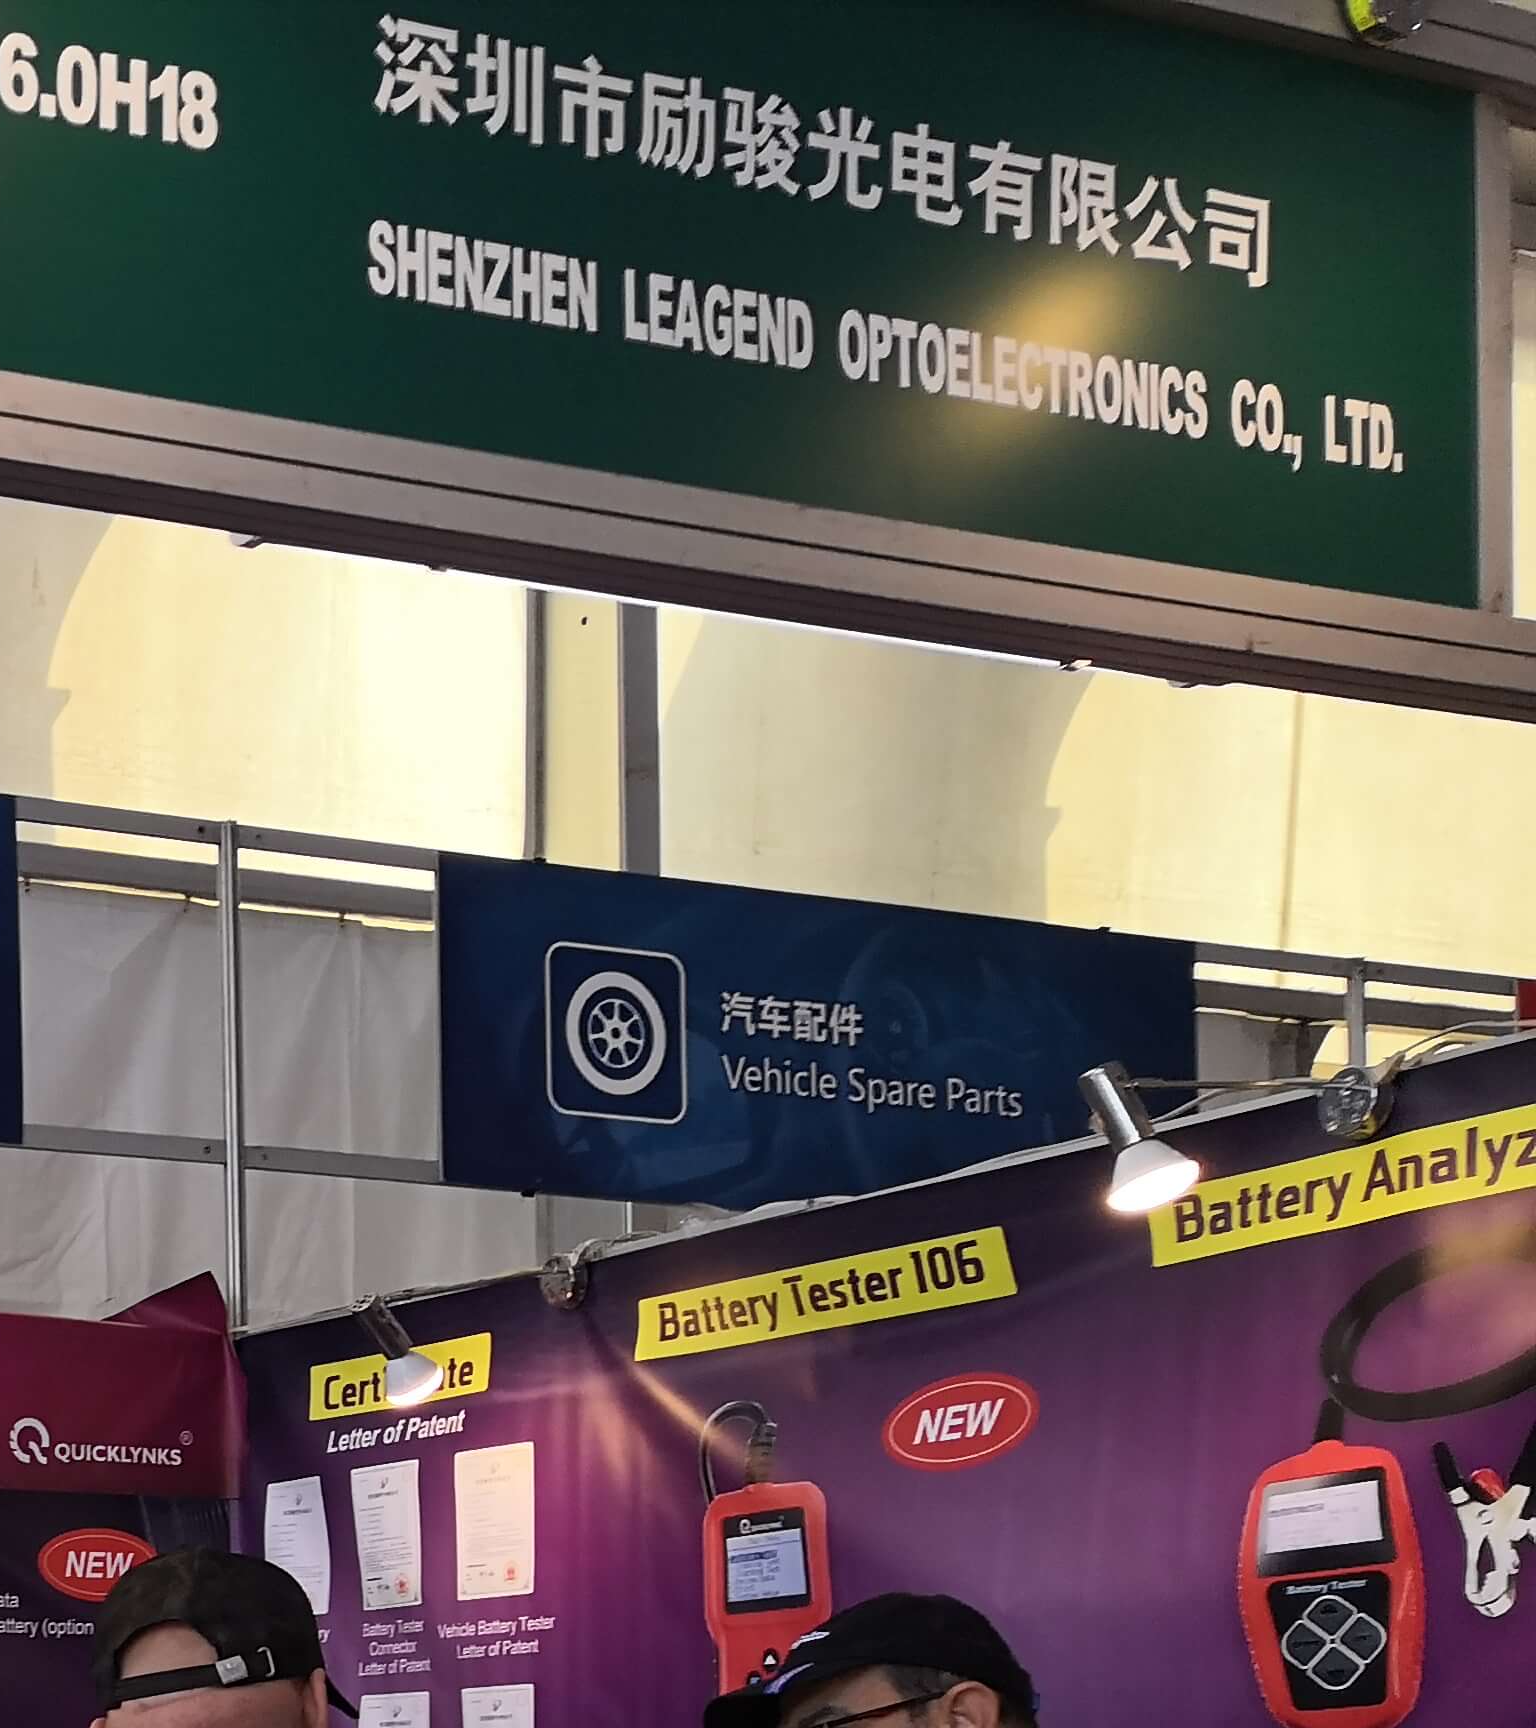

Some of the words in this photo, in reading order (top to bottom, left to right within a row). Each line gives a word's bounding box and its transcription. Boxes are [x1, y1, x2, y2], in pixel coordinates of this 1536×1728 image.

[372, 12, 1274, 290] 深圳市励骏光电有限公司
[367, 220, 598, 332] SHENZHEN
[624, 269, 813, 369] LEAGEND
[838, 311, 1207, 439] OPTOELECTRONICS
[1230, 378, 1302, 473] CO.,
[1325, 394, 1403, 474] LTD.
[719, 990, 864, 1047] 汽车配件
[722, 1055, 836, 1099] Vehicle
[848, 1067, 935, 1113] Spare
[948, 1077, 1022, 1117] Parts
[1175, 1172, 1352, 1243] Battery
[659, 1292, 777, 1342] Battery
[782, 1267, 902, 1316] Tester
[910, 1244, 984, 1294] 106
[326, 1428, 381, 1453] Letter
[383, 1418, 407, 1445] of
[405, 1408, 466, 1441] Patent
[912, 1398, 1005, 1445] NEW
[55, 1443, 182, 1466] QUICKLYNKS
[65, 1551, 134, 1578] NEW
[438, 1622, 476, 1638] Vehicle
[478, 1620, 517, 1636] Battery
[518, 1615, 555, 1631] Tester
